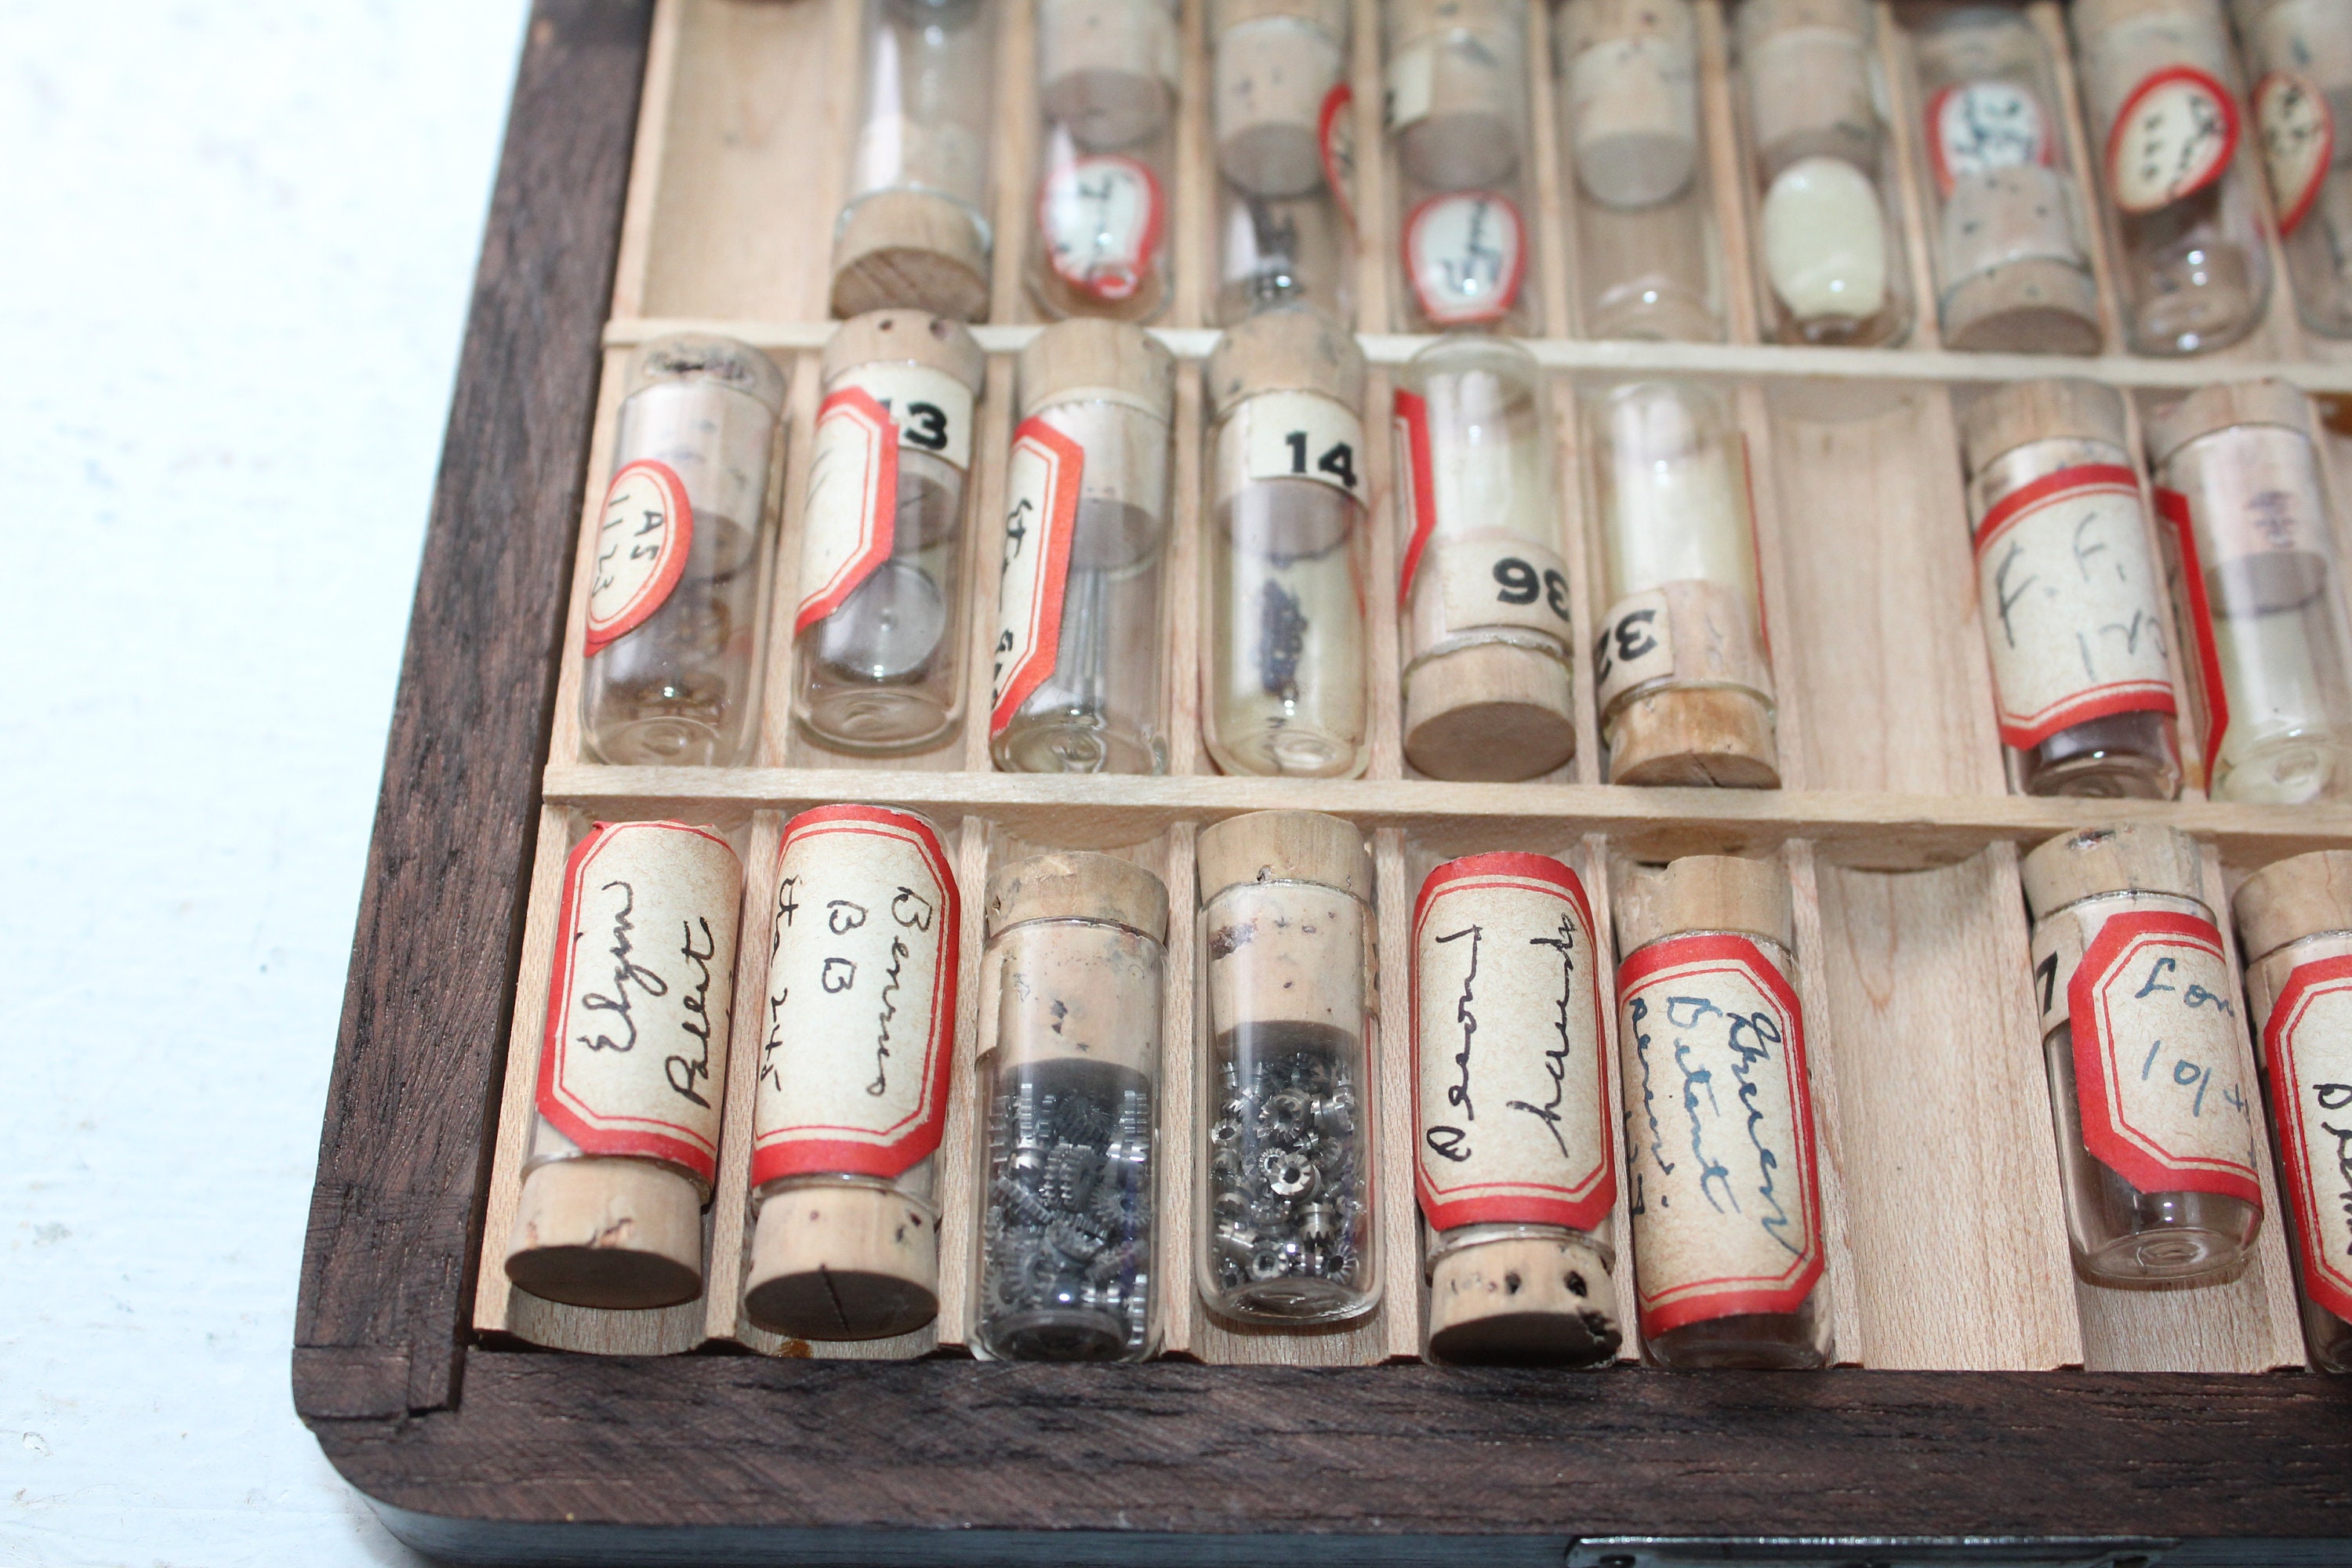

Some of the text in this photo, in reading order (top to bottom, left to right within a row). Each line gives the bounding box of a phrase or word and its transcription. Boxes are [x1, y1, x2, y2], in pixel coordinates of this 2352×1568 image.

[877, 398, 948, 450] 3
[1285, 430, 1358, 488] 14
[1493, 557, 1570, 622] 36
[574, 880, 667, 1053] Elgin
[866, 886, 932, 1096] Benrus
